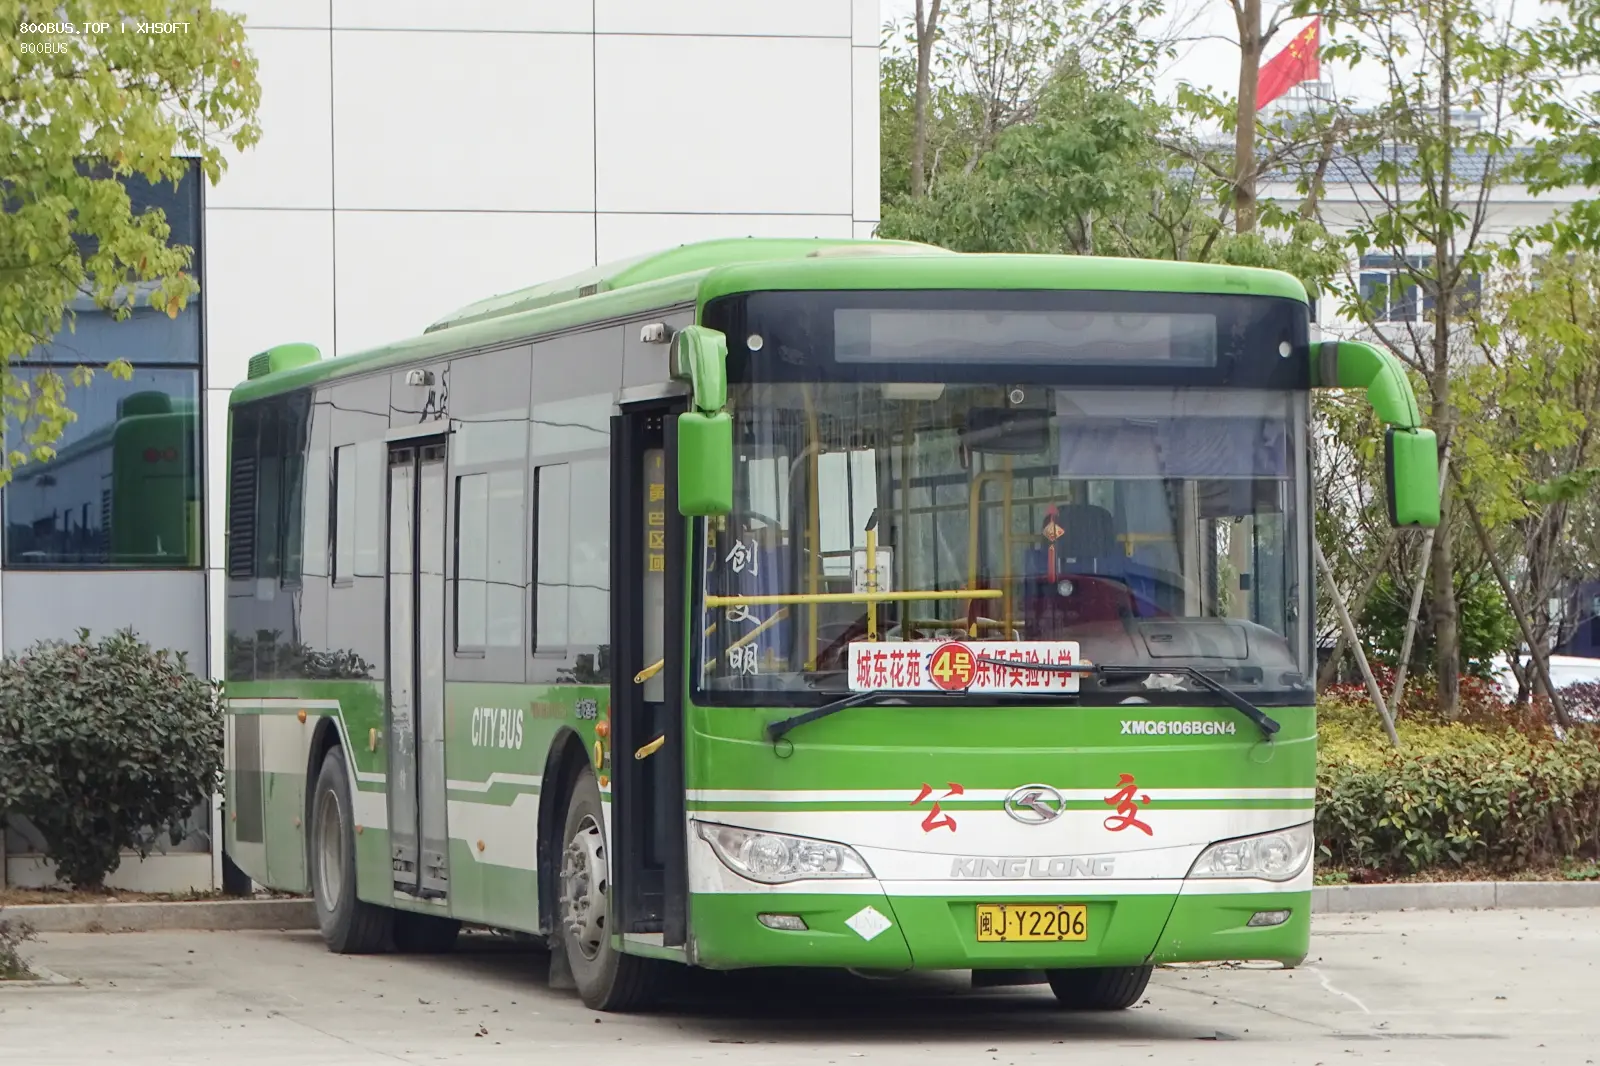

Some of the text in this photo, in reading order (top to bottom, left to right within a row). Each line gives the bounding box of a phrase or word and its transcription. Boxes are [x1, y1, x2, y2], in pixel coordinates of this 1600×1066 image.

[856, 649, 921, 688] 城东花苑
[933, 651, 972, 683] 4号
[471, 707, 498, 747] CITY
[498, 708, 524, 750] BUS
[1120, 720, 1236, 736] XMQ6106BGN4
[909, 773, 1154, 837] 公 交
